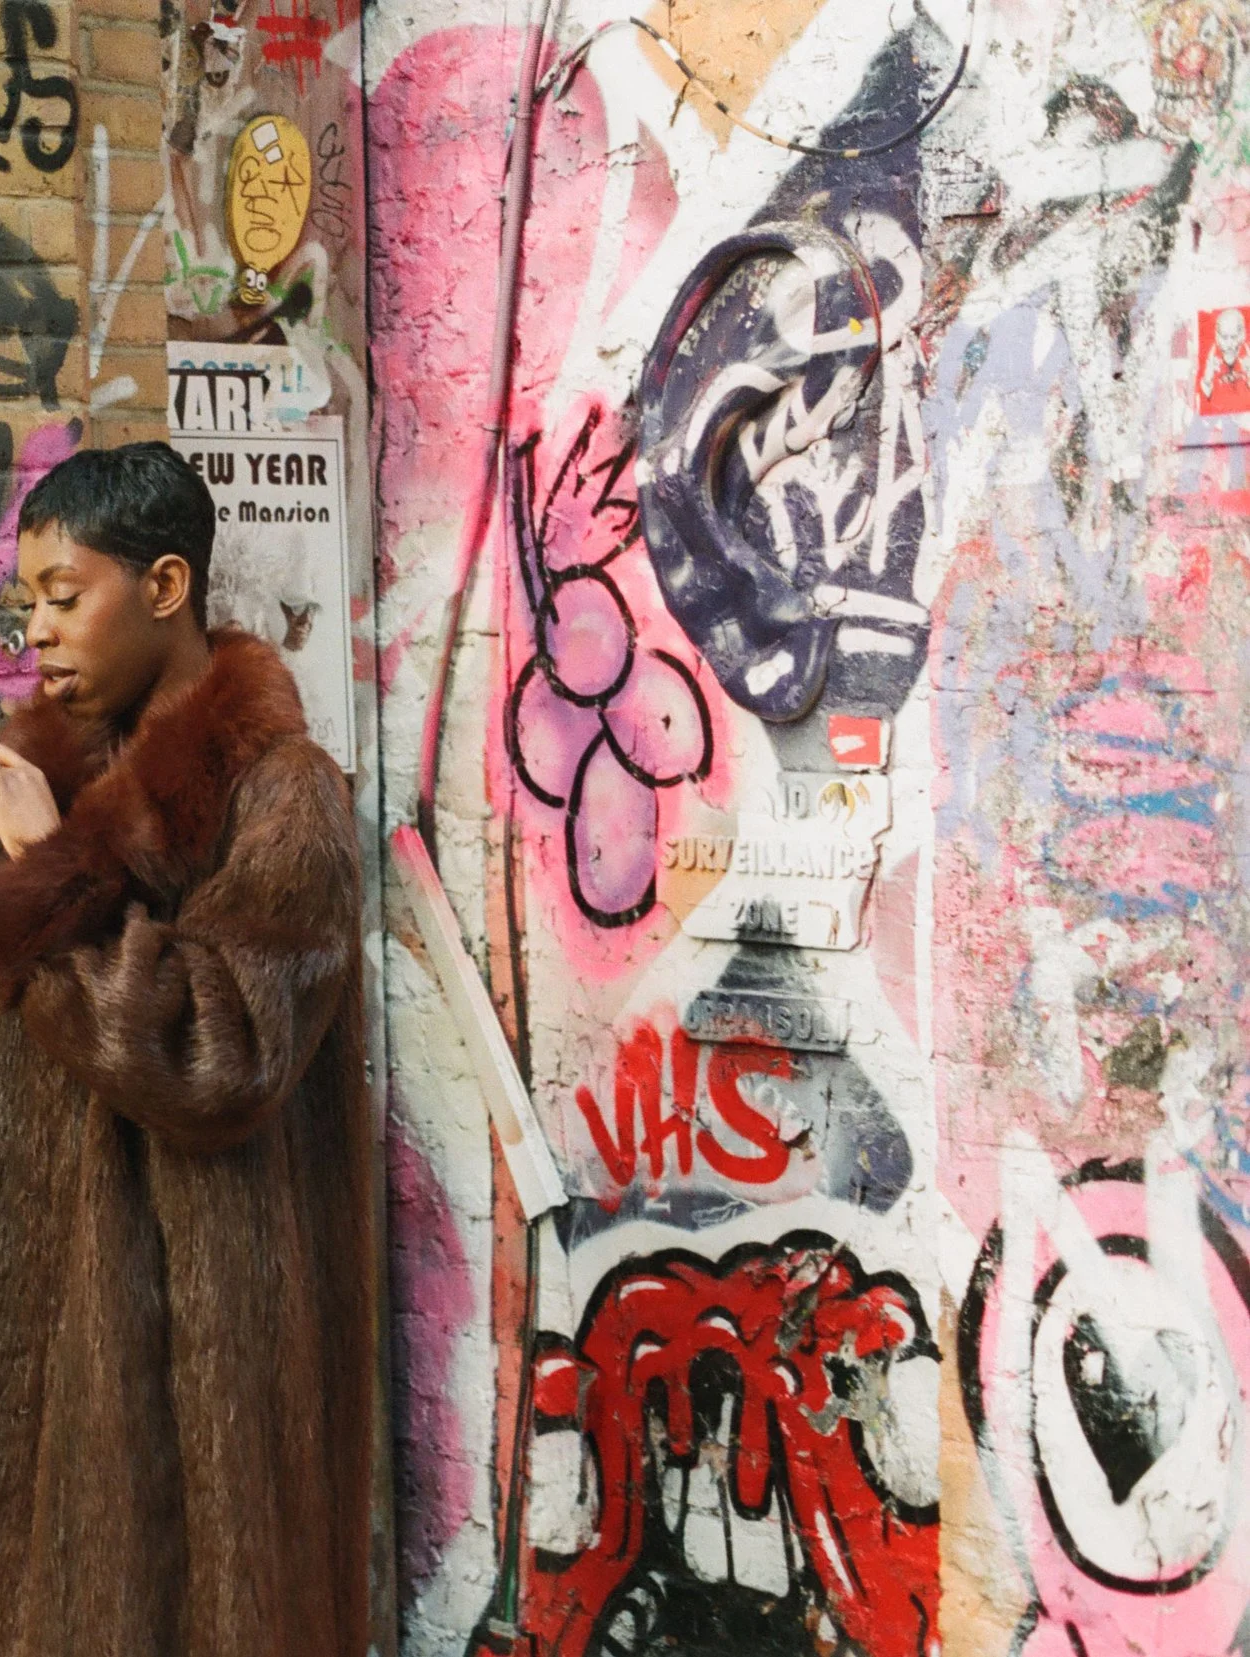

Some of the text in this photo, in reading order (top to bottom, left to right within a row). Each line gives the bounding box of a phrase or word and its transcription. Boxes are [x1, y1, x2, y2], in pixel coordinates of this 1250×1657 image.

[190, 452, 327, 486] EW YEAR
[238, 500, 330, 523] Mansion
[660, 836, 874, 882] SURVEILLANCE
[722, 896, 799, 935] ZONE
[575, 1018, 792, 1186] VHS
